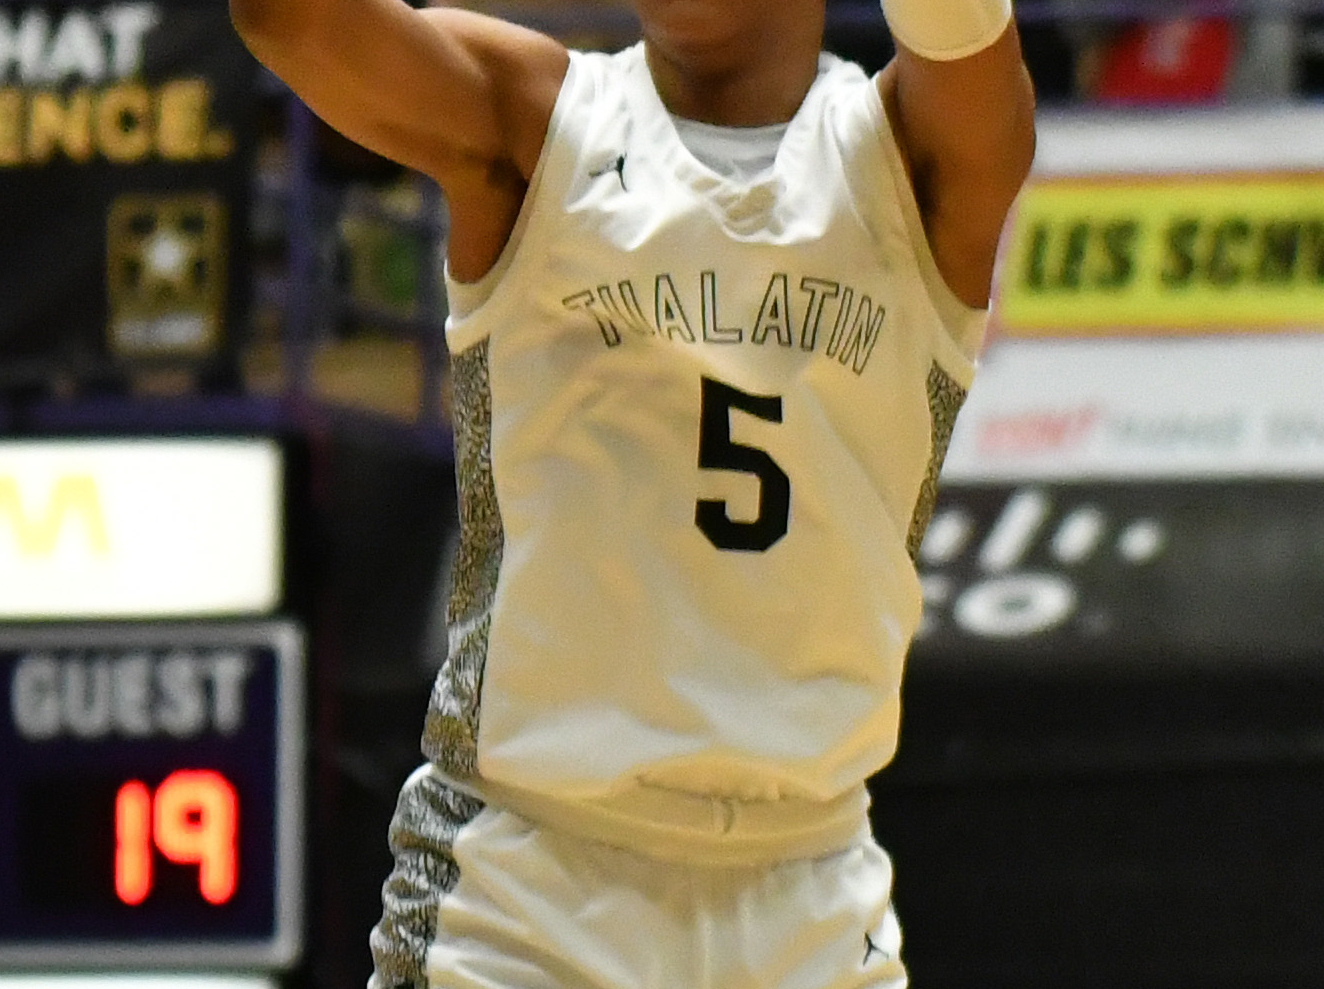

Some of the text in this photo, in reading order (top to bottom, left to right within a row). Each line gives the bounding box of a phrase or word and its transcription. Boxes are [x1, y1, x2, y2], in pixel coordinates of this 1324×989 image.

[562, 271, 886, 377] TUALATIN
[694, 374, 791, 554] 5
[11, 653, 252, 740] GUEST
[114, 767, 239, 906] 19
